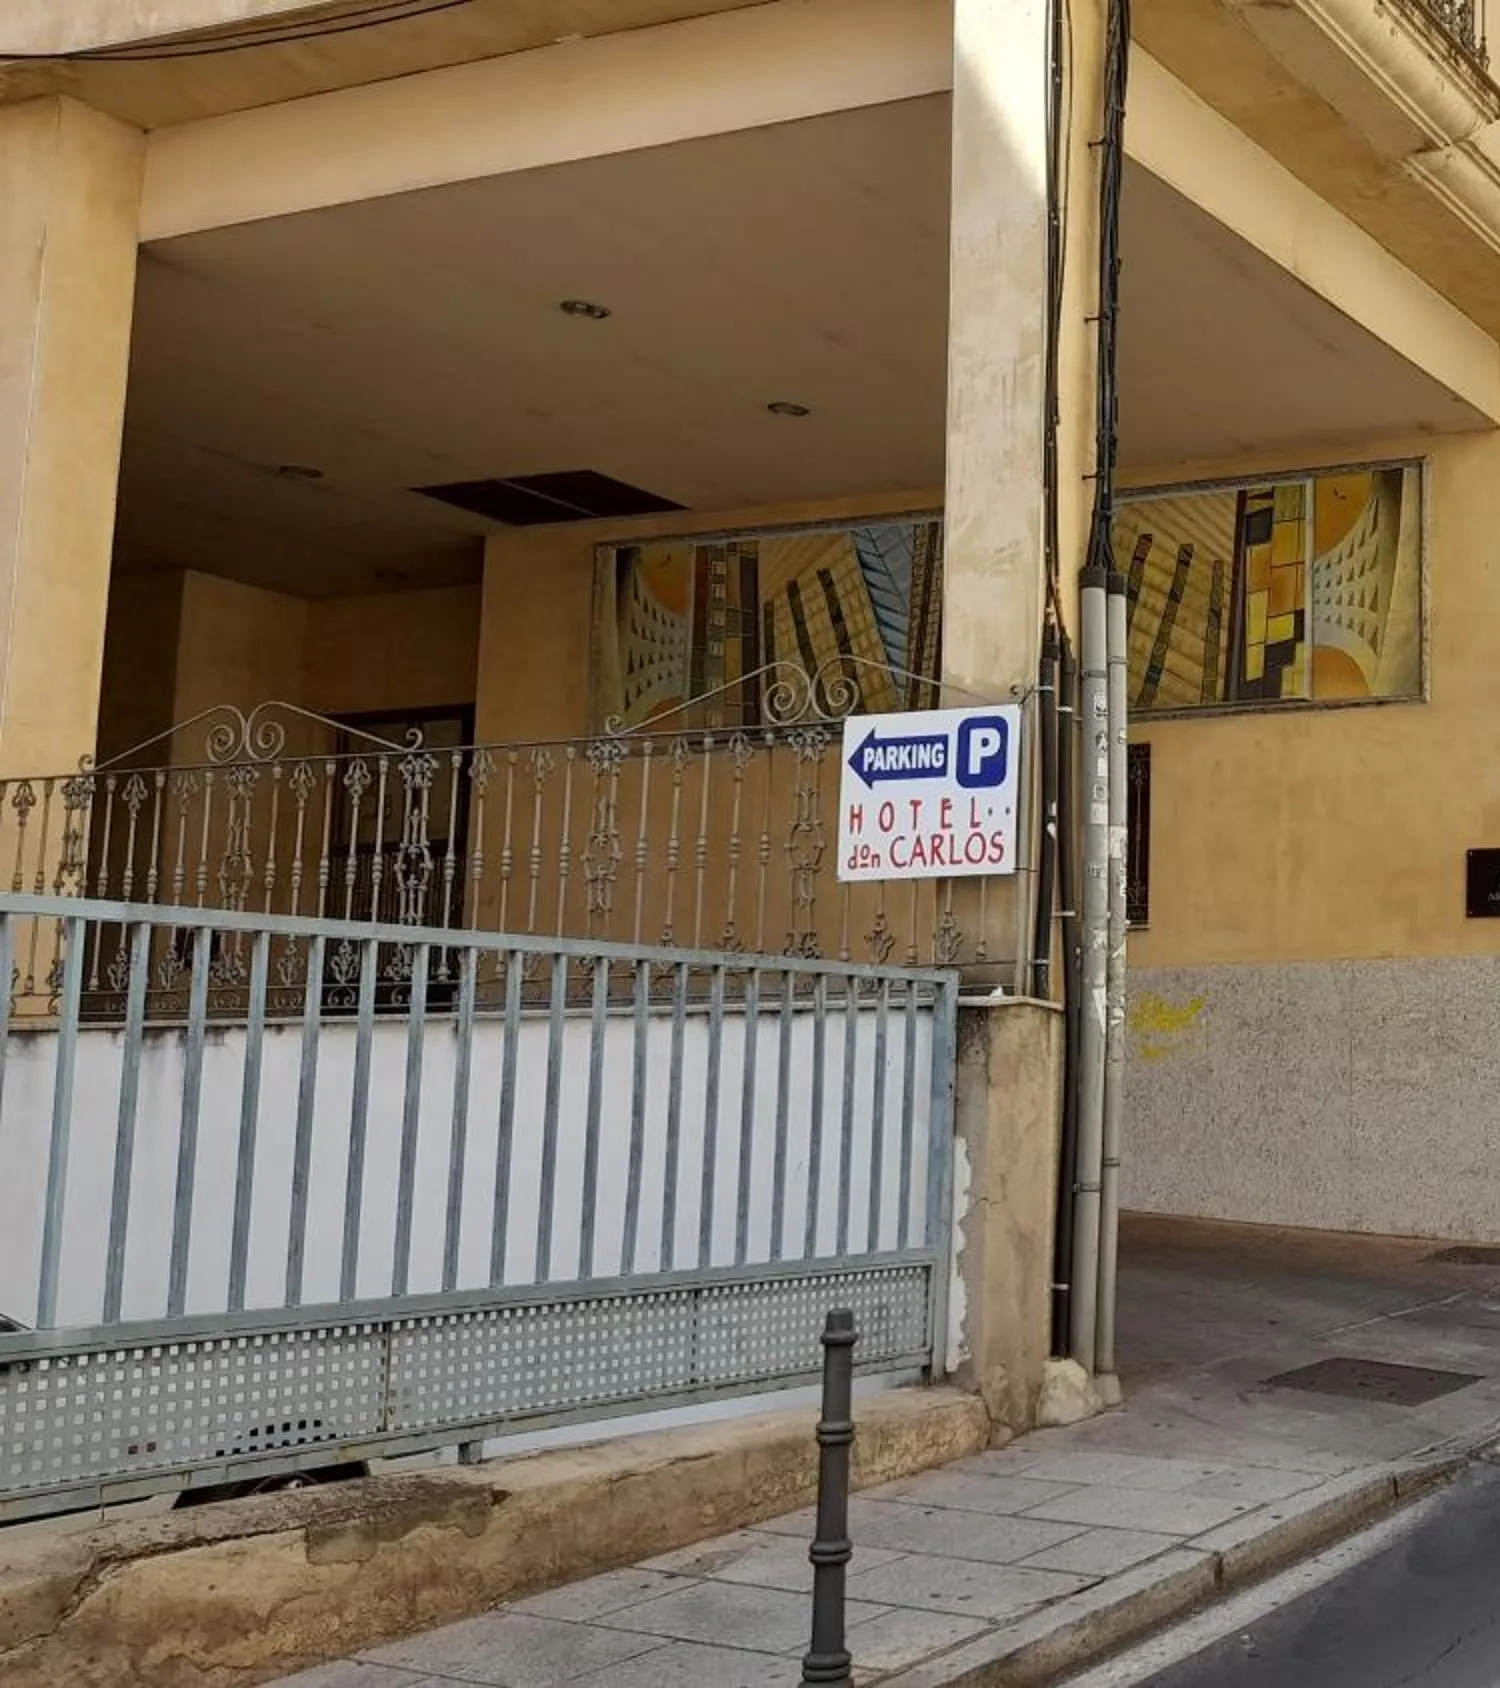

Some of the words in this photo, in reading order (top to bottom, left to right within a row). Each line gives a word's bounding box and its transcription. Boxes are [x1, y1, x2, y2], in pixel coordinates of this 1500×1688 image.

[863, 743, 945, 772] PARKING
[968, 727, 1001, 775] P
[889, 831, 1005, 869] CARLOS
